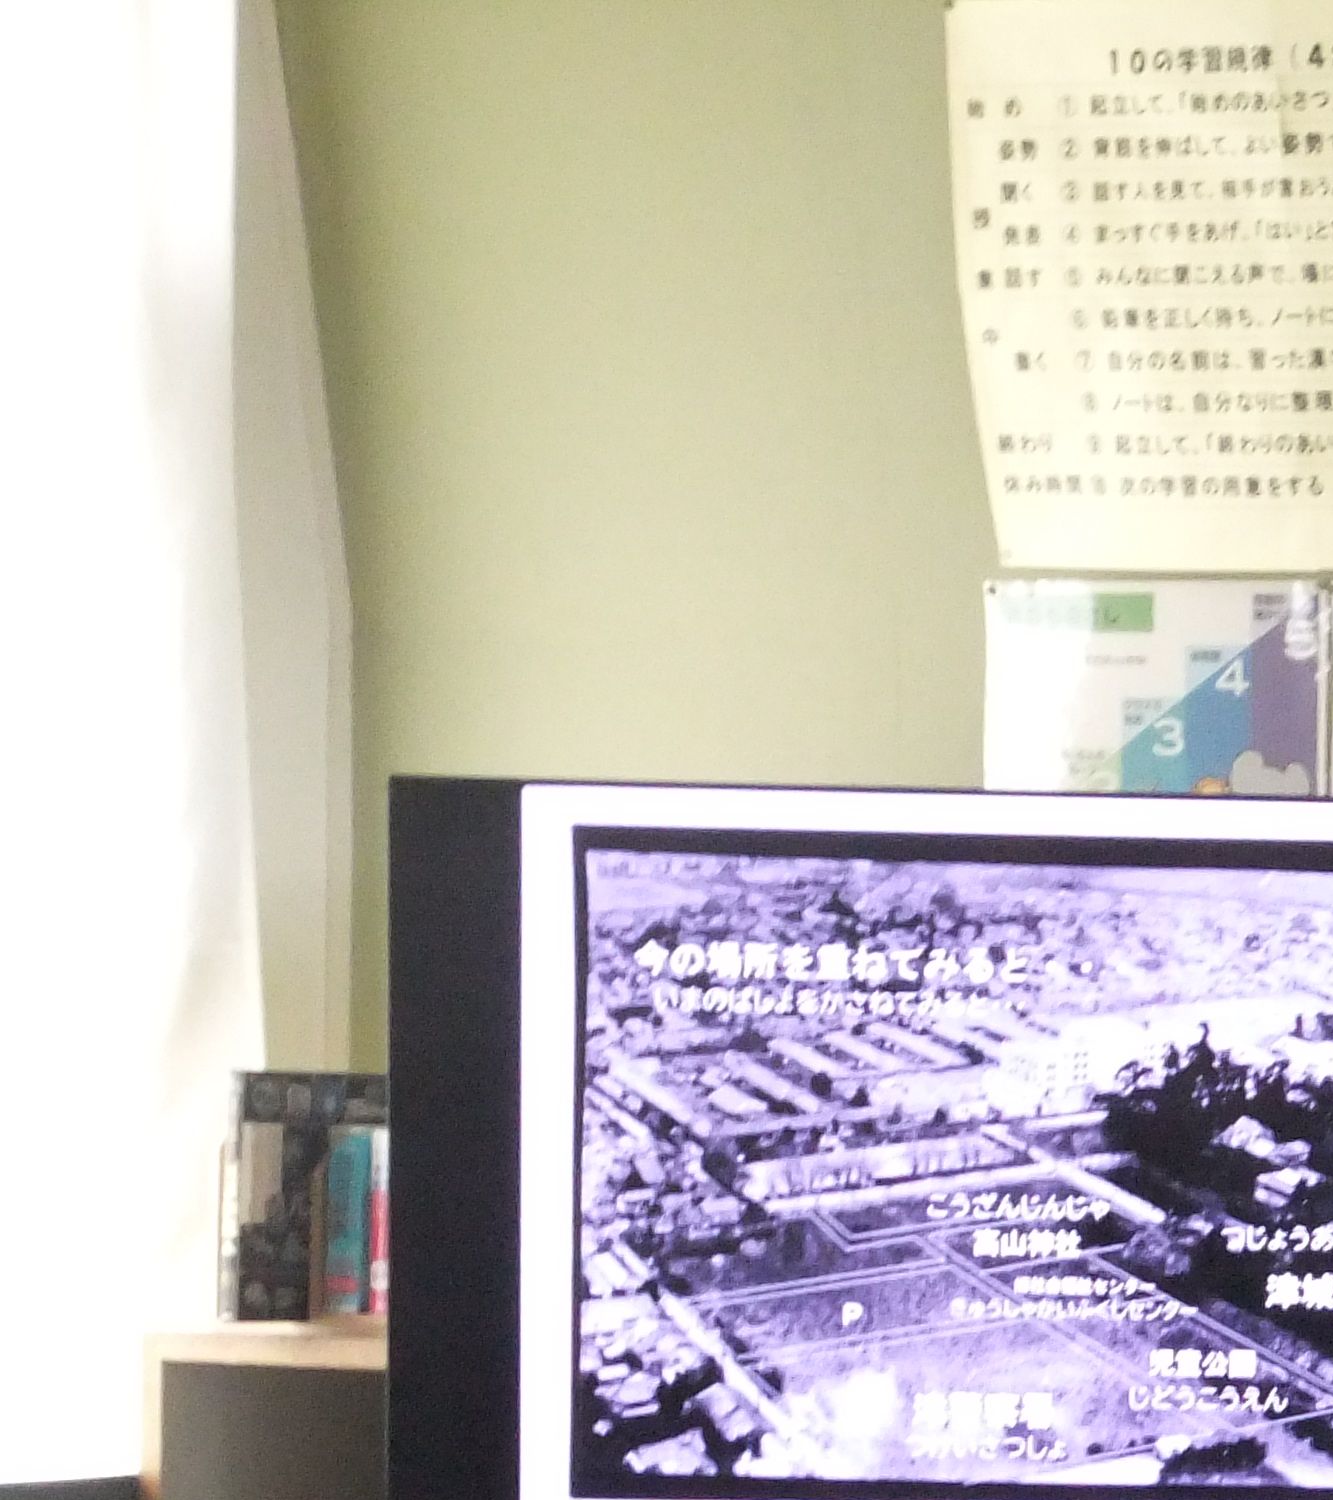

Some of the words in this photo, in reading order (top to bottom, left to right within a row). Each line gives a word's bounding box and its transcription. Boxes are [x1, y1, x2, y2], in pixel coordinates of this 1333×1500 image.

[1215, 658, 1249, 696] 4
[1152, 719, 1184, 756] 3
[926, 1191, 1111, 1222] こうざんじんじゃ
[1128, 1384, 1288, 1414] じどうこうえん
